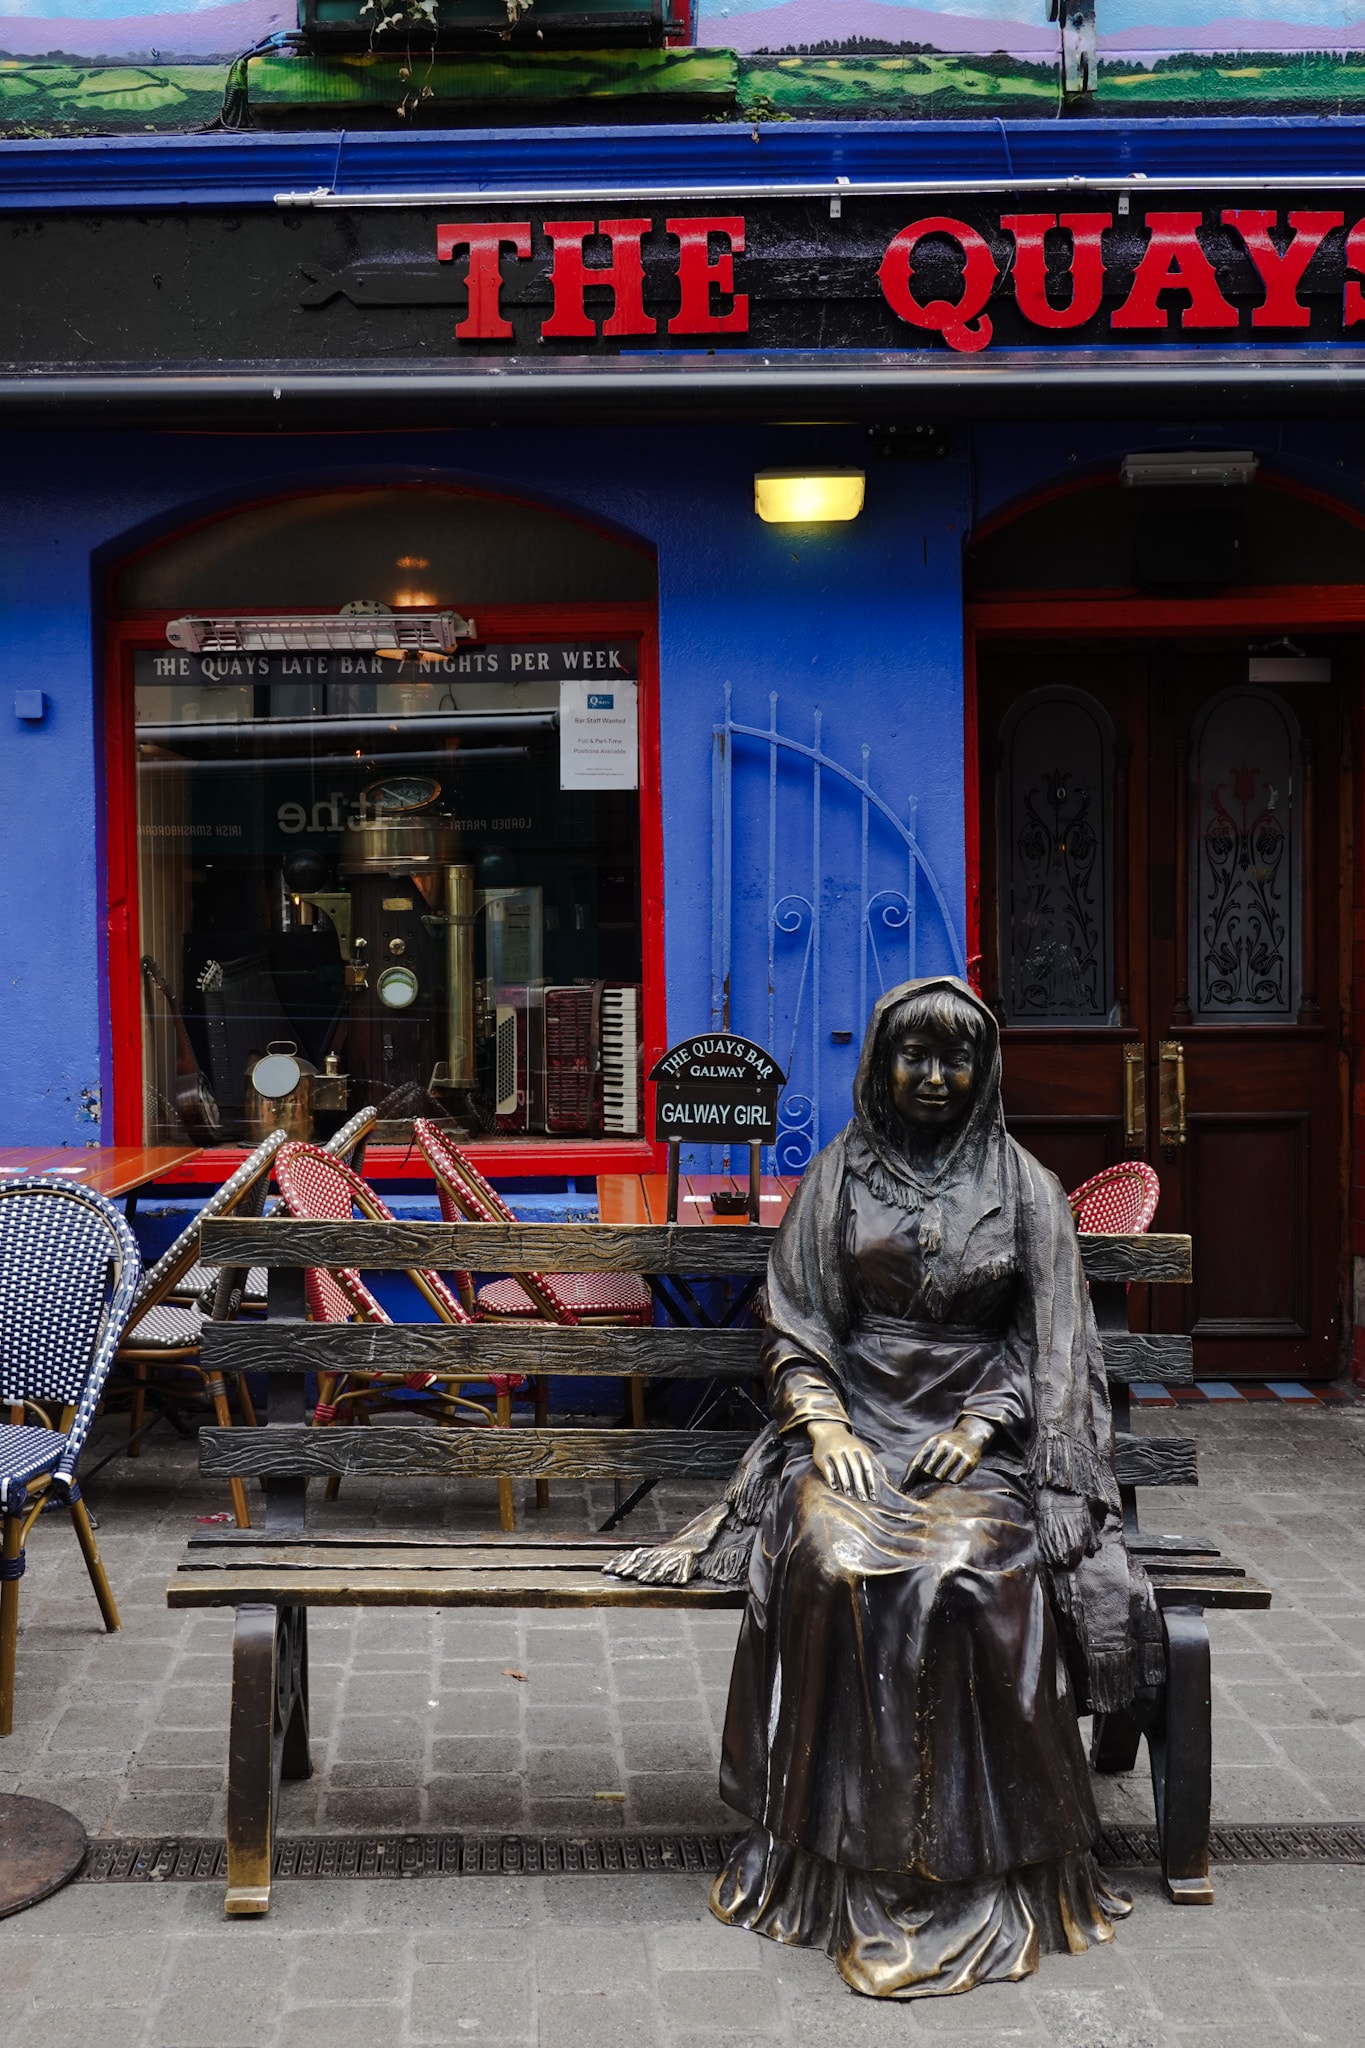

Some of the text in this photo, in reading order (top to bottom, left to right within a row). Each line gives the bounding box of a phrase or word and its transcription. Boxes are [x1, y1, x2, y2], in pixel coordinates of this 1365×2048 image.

[436, 216, 749, 338] THE
[153, 657, 190, 676] THE
[201, 657, 270, 681] QUAYS
[281, 657, 328, 674] LATE
[341, 656, 384, 674] BAR
[418, 653, 499, 674] NIGHTS
[510, 652, 550, 671] PER
[562, 650, 622, 669] WEEK
[661, 1039, 774, 1079] THE QUAYS BAR
[690, 1065, 746, 1078] GALWAY
[661, 1102, 771, 1126] GALWAY GIRL
